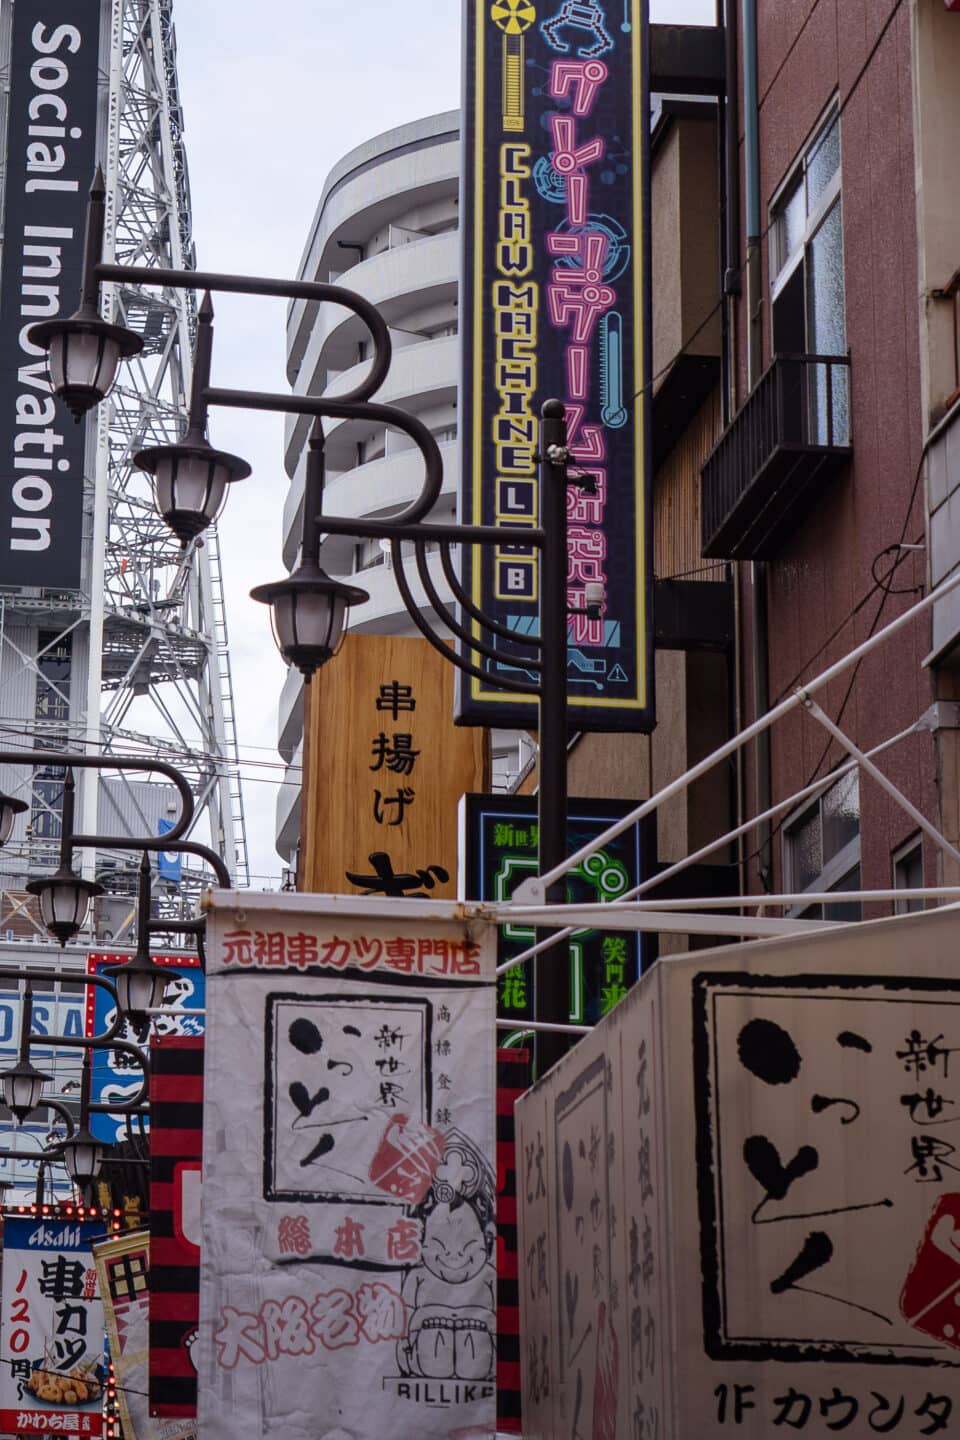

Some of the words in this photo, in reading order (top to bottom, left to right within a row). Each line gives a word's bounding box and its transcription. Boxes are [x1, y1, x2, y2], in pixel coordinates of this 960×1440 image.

[24, 22, 81, 193] Social
[497, 143, 533, 276] CLAW
[493, 279, 538, 474] MACHINE
[369, 679, 420, 827] 串揚げ
[222, 930, 482, 976] 元祖串カツ専門店
[374, 1024, 413, 1108] 新世界
[435, 1005, 453, 1126] 商標登録
[896, 1029, 960, 1183] 新世界
[28, 1224, 82, 1248] Asahi
[277, 1215, 421, 1261] 総本店
[37, 1254, 89, 1371] 串カツ
[216, 1282, 408, 1369] 大阪名物
[16, 1411, 80, 1431] かわち屋
[714, 1383, 756, 1425] 1F
[772, 1386, 953, 1436] カウンタ
